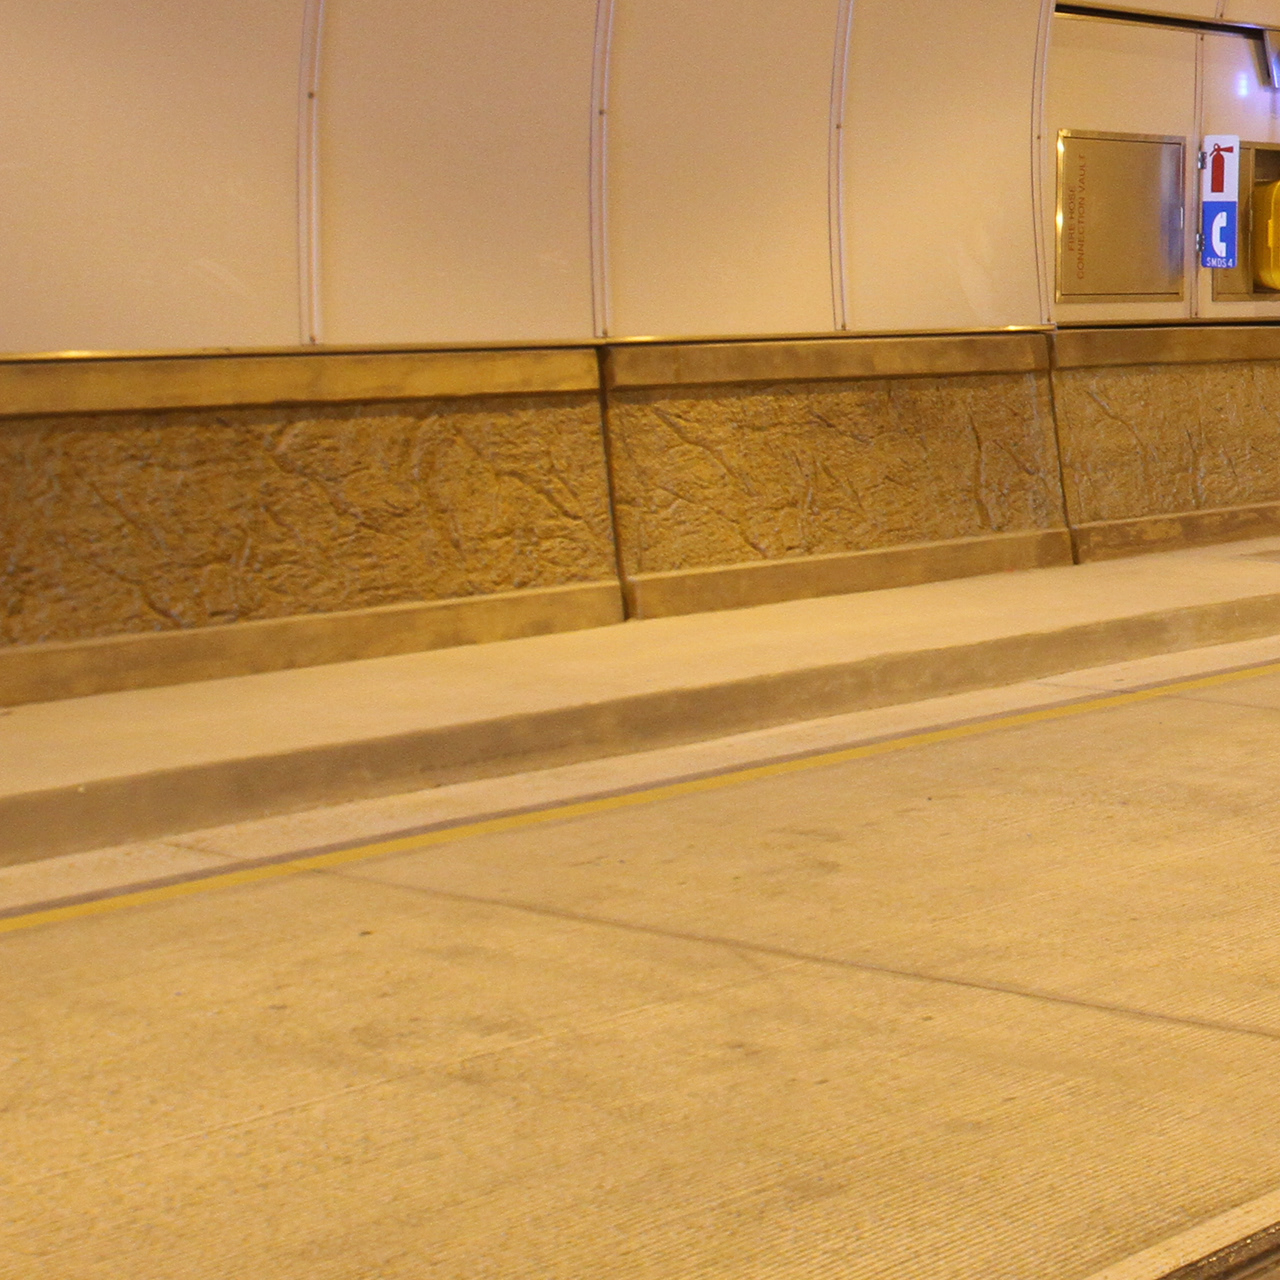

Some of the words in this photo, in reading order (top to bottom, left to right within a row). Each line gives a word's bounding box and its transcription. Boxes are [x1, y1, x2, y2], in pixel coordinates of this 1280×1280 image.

[1078, 154, 1086, 193] VAULT
[1068, 186, 1076, 220] HOSE
[1068, 222, 1076, 252] FIRE
[1077, 196, 1085, 280] CONNECTION
[1228, 258, 1233, 268] 4
